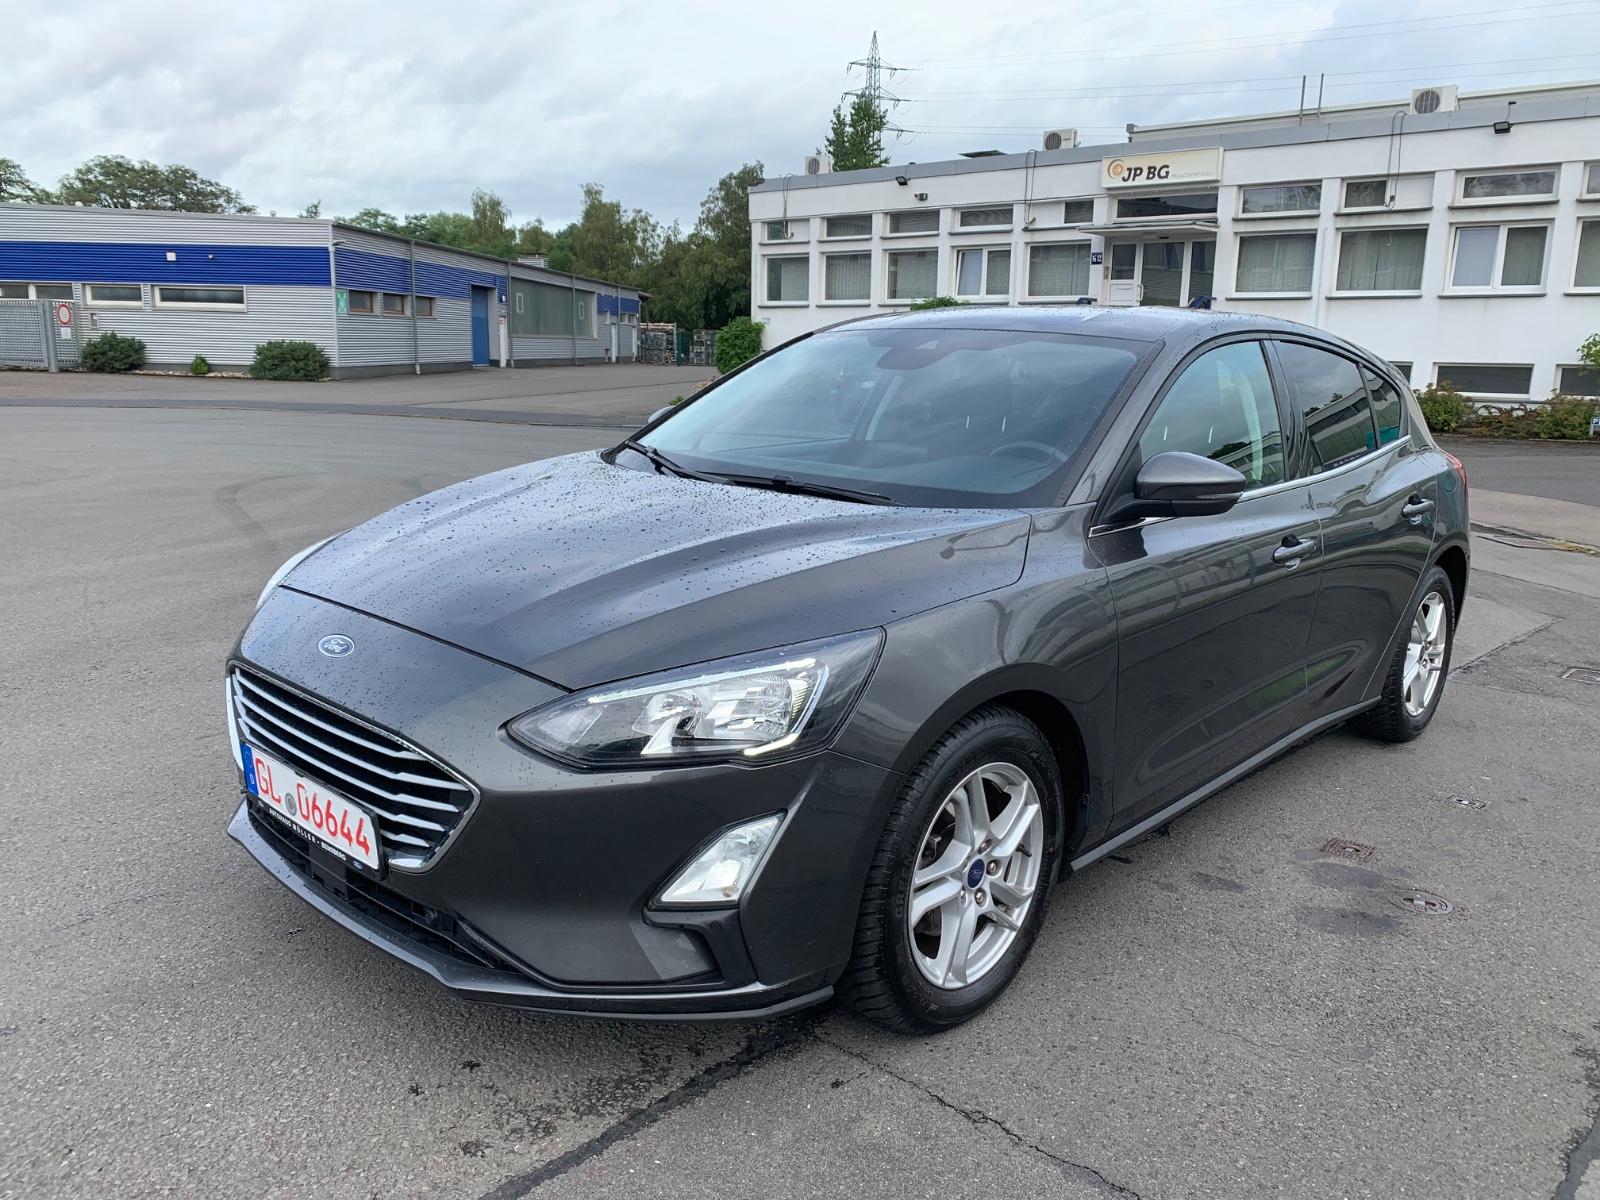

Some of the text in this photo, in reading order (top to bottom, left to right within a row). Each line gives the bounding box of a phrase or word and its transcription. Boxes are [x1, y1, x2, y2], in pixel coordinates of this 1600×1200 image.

[1122, 167, 1143, 182] JP
[1146, 165, 1170, 180] BG
[255, 757, 370, 856] GL 06644
